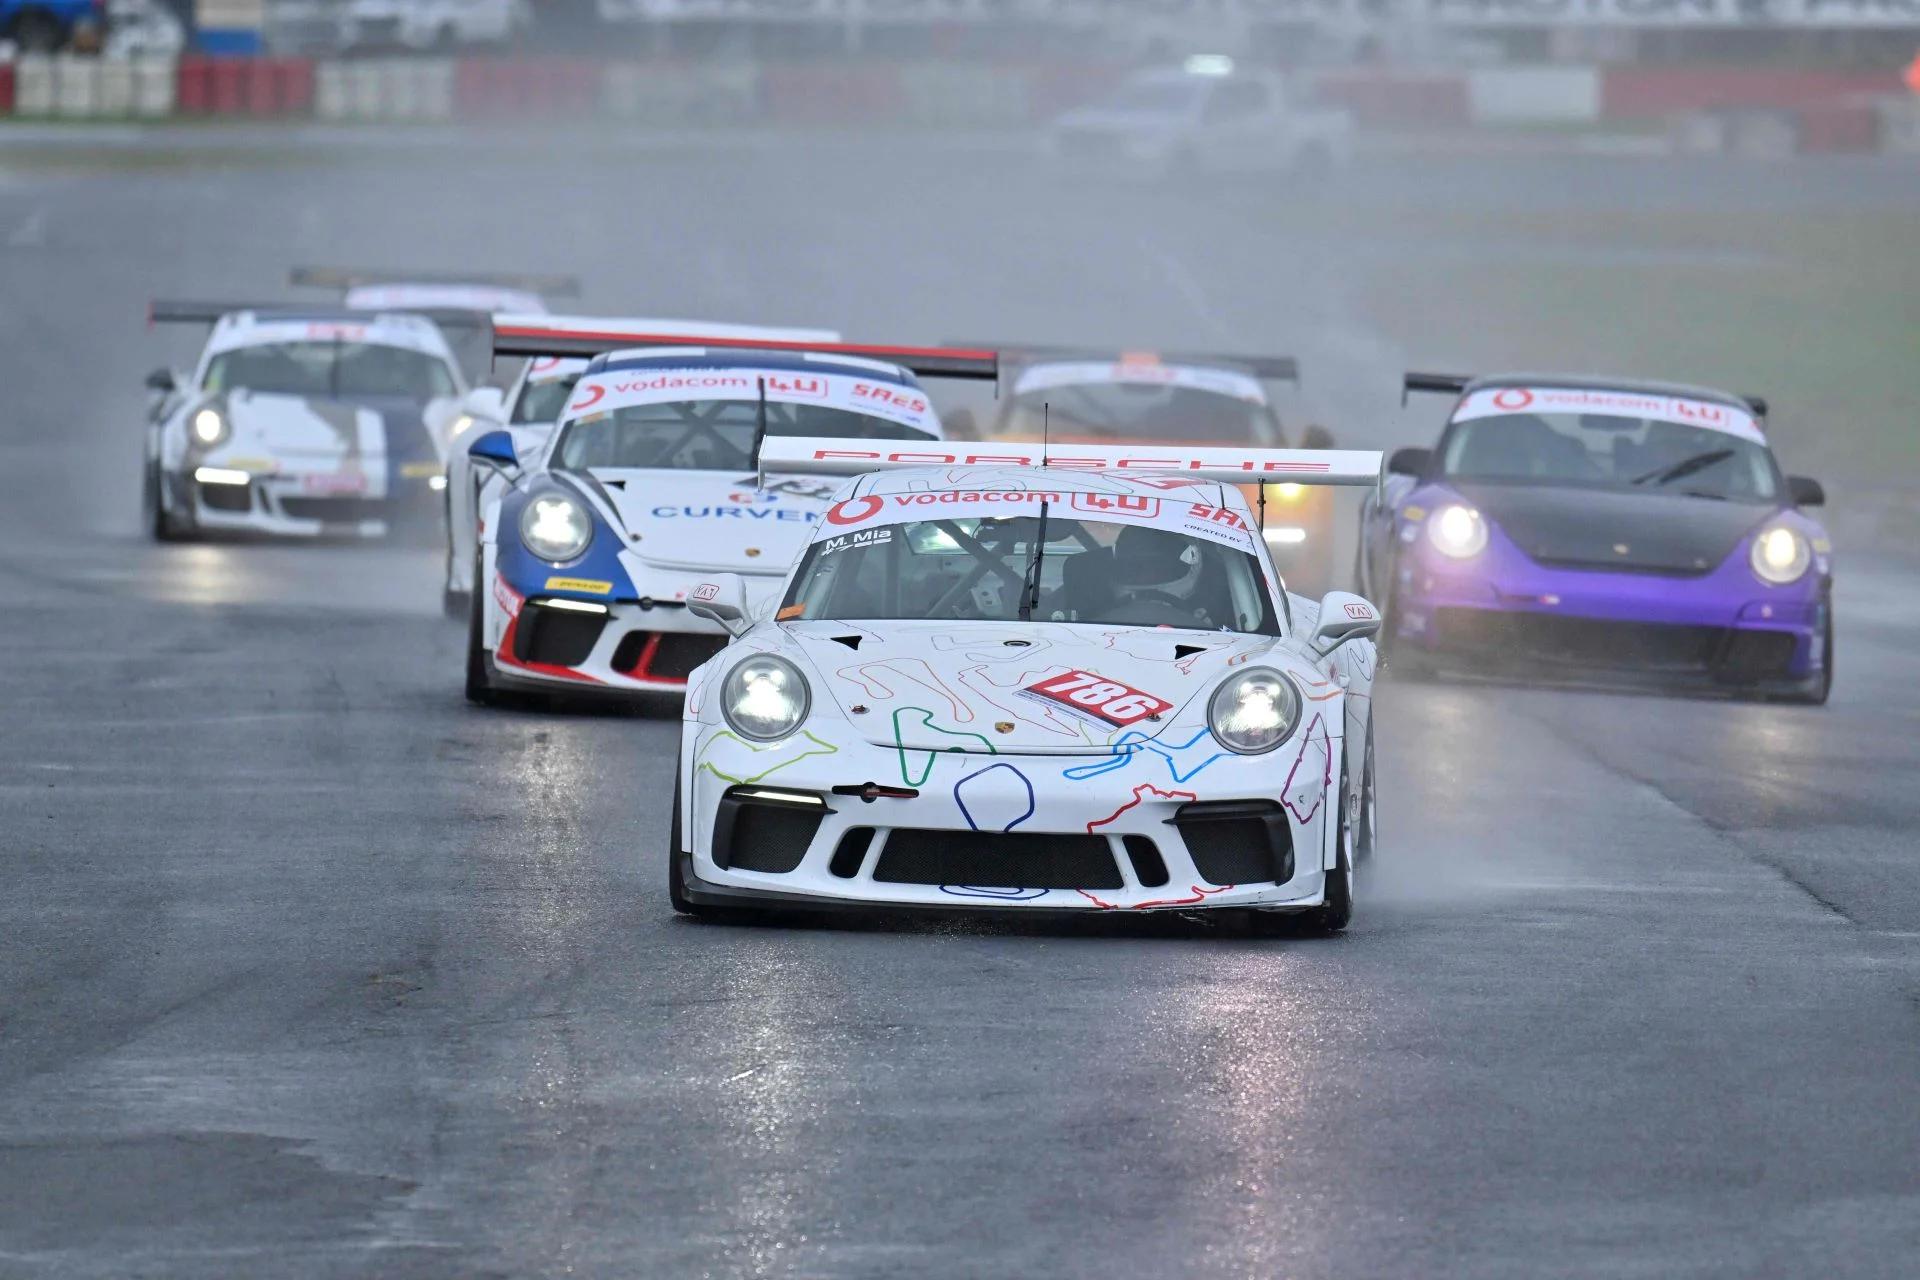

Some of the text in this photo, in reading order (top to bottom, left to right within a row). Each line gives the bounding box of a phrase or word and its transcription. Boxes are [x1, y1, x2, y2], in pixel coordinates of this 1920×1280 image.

[614, 376, 818, 393] vodacom 4U
[1542, 392, 1661, 410] vodacom
[813, 450, 1331, 473] PORSCHE
[894, 489, 1061, 506] vodacom
[1187, 502, 1249, 531] SA
[825, 529, 892, 550] M. Mia
[1184, 523, 1228, 539] CREATED
[1043, 673, 1160, 719] 786
